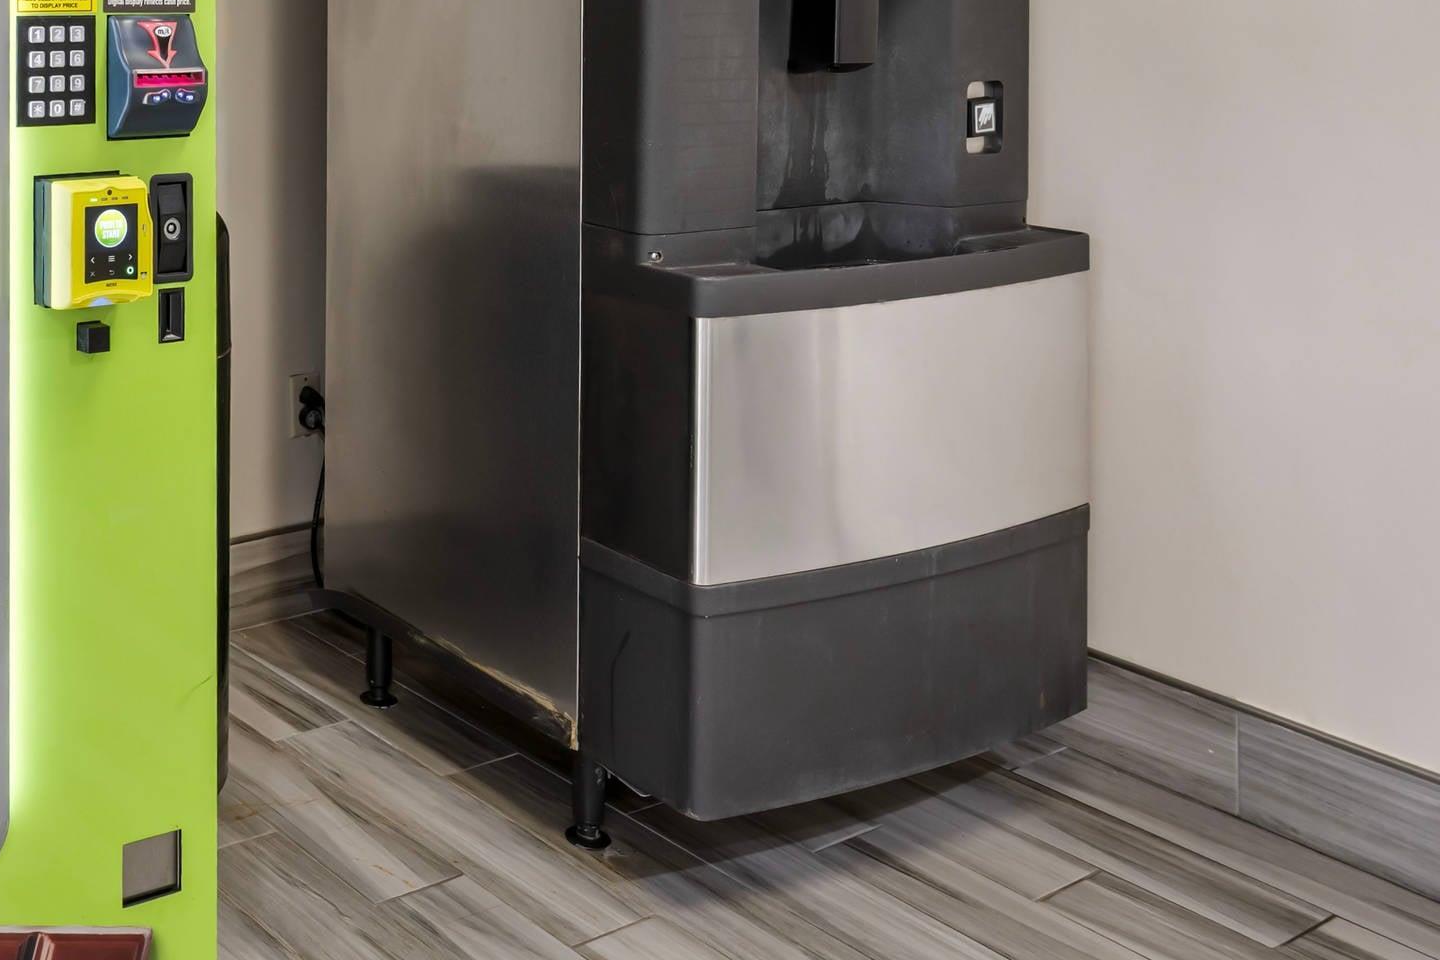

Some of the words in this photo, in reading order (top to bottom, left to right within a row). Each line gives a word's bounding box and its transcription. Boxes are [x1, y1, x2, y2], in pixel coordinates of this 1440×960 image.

[34, 29, 42, 40] 1
[54, 28, 62, 39] 2
[74, 28, 82, 39] 3
[33, 54, 42, 64] 4
[54, 54, 62, 64] 5
[73, 53, 81, 64] 6
[34, 79, 42, 90] 7
[54, 79, 62, 90] 8
[73, 78, 81, 89] 9
[54, 103, 62, 114] 0
